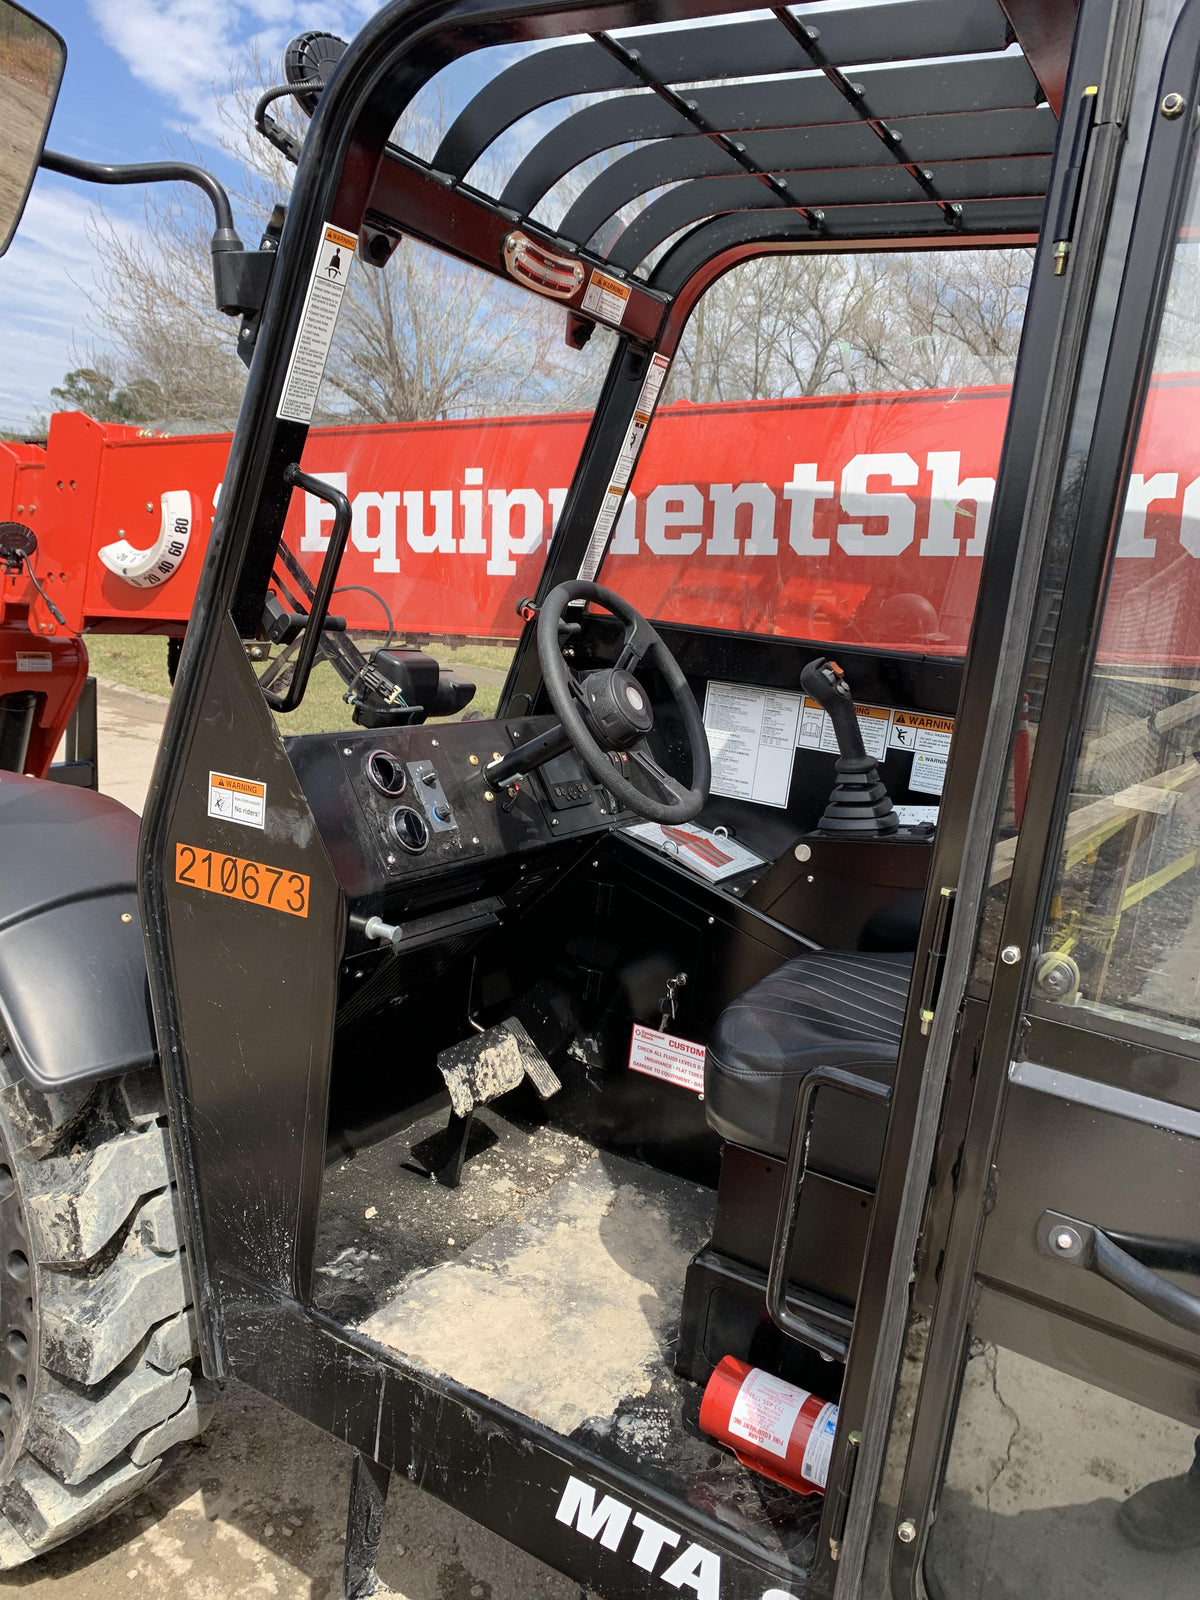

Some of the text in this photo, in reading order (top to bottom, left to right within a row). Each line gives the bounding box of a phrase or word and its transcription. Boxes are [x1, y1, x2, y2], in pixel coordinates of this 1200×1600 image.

[174, 517, 190, 534] 80
[168, 540, 184, 557] 60
[158, 560, 174, 575] 40
[144, 573, 160, 585] 20
[226, 780, 258, 794] WARNING
[177, 845, 305, 913] 210673
[642, 1030, 665, 1040] Equipment
[637, 1045, 653, 1054] CHECK
[663, 1053, 678, 1062] FLUID
[679, 1058, 697, 1068] LEVELS
[632, 1061, 653, 1071] DAMAGE
[661, 1070, 690, 1084] EQUIPMENT
[644, 1056, 704, 1080] INSURANCE FLAT TIRES
[743, 1422, 772, 1440] EQUIPMENT
[748, 1432, 765, 1444] CLARK
[772, 1434, 784, 1446] FIRE
[554, 1475, 722, 1600] MTA
